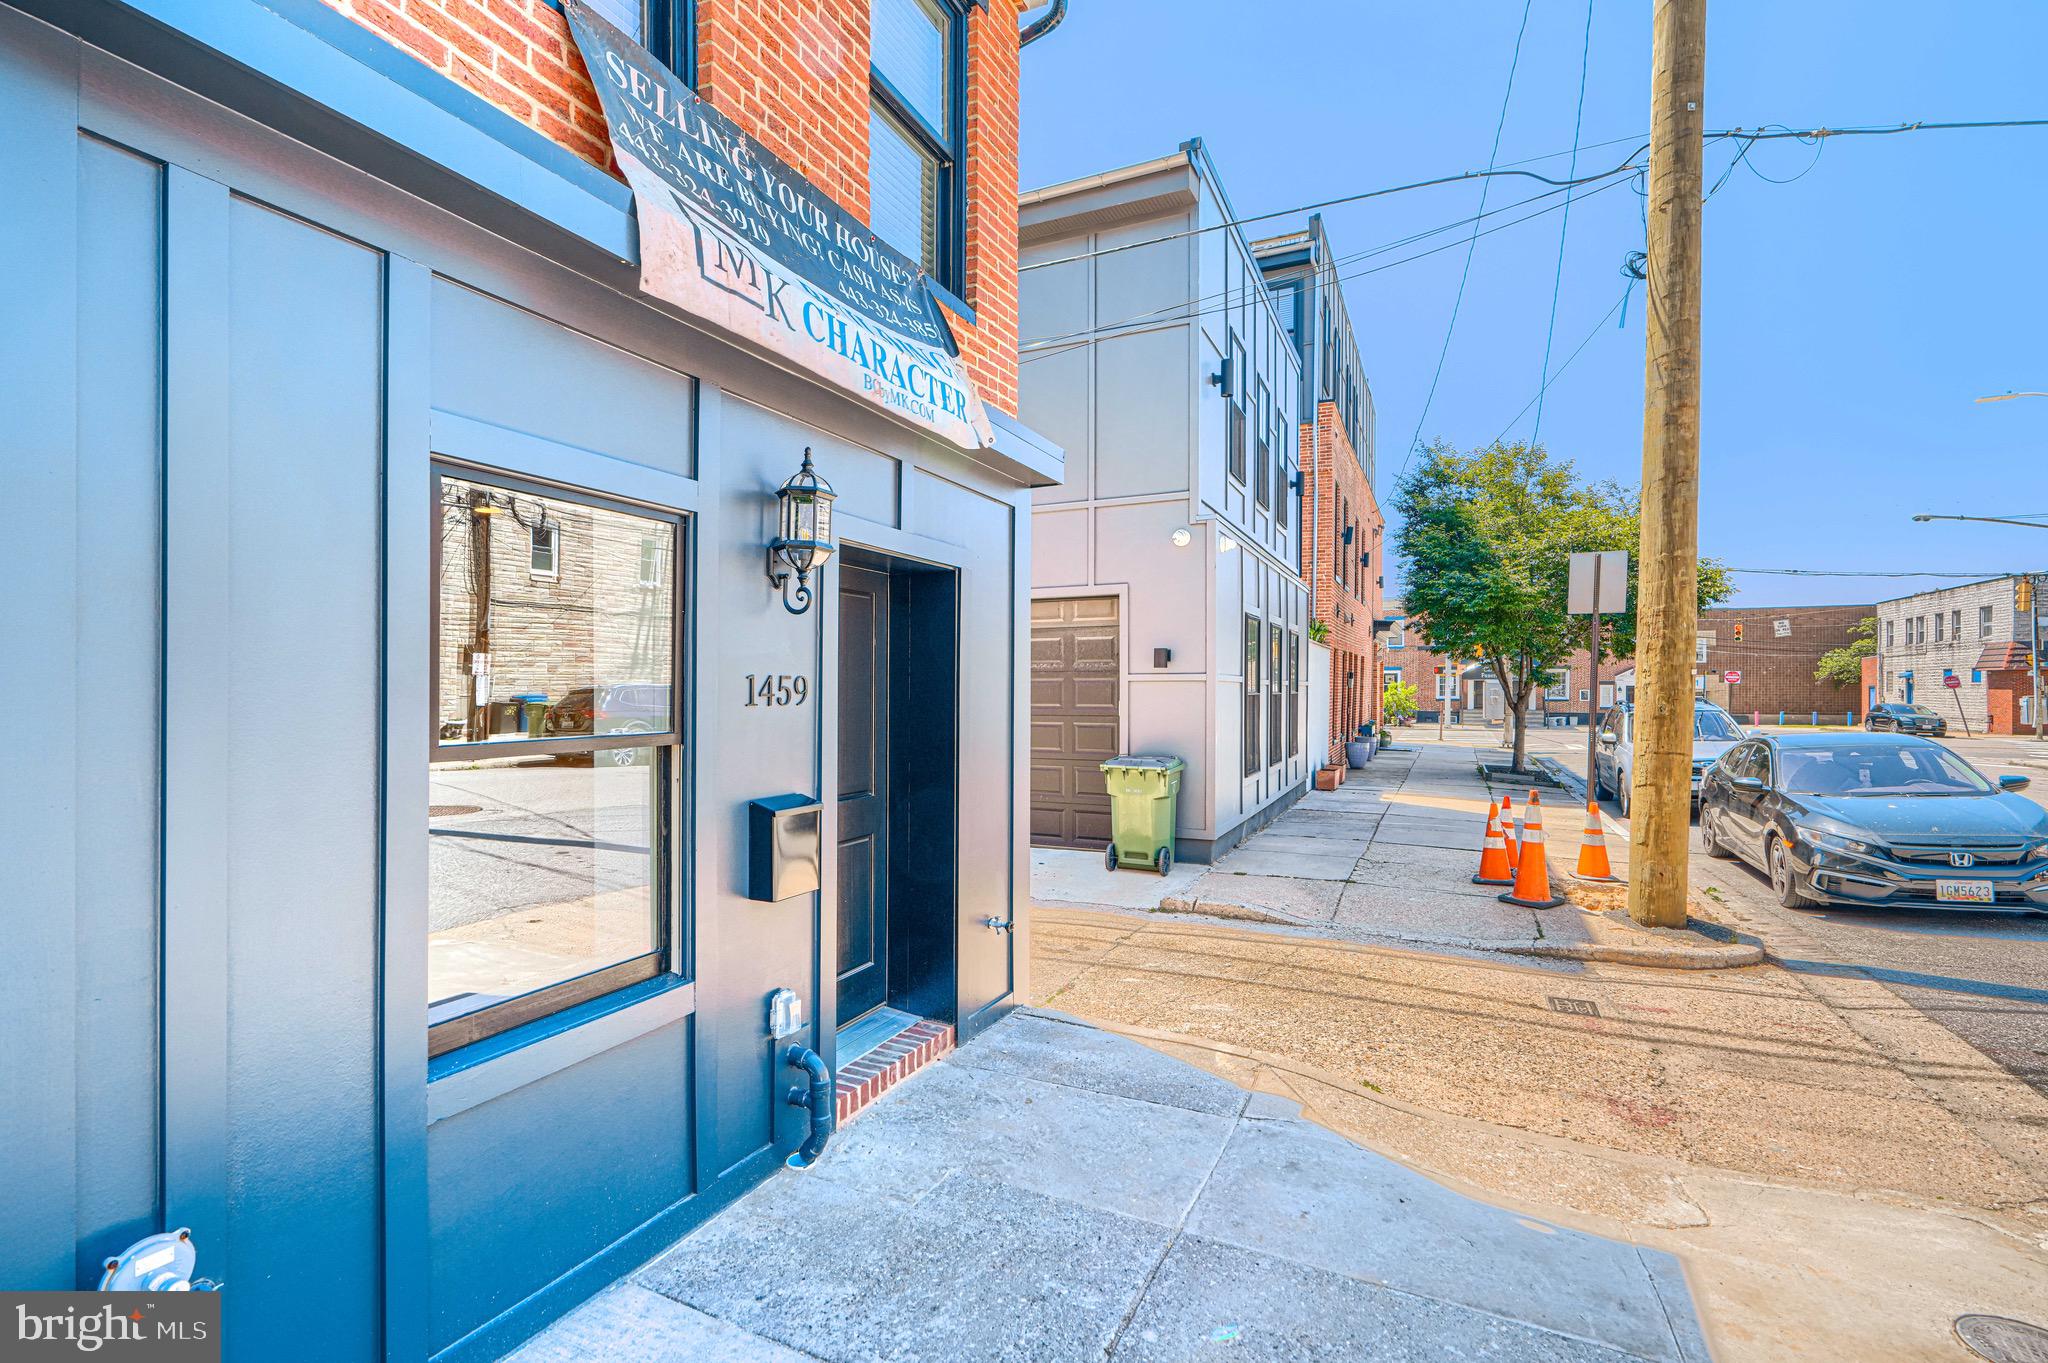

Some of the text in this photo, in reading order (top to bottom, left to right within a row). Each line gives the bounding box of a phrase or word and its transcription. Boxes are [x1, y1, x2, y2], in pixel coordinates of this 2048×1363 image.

[605, 50, 913, 292] SELLING YOUR HOUSE?
[617, 92, 669, 151] WE
[677, 141, 733, 193] ARE
[735, 179, 825, 261] BUYING!
[827, 250, 877, 295] CASH
[618, 121, 771, 247] 443-324-3919
[803, 301, 968, 424] CHARACTER
[744, 673, 809, 707] 1459
[1940, 885, 1990, 898] 1GM5623
